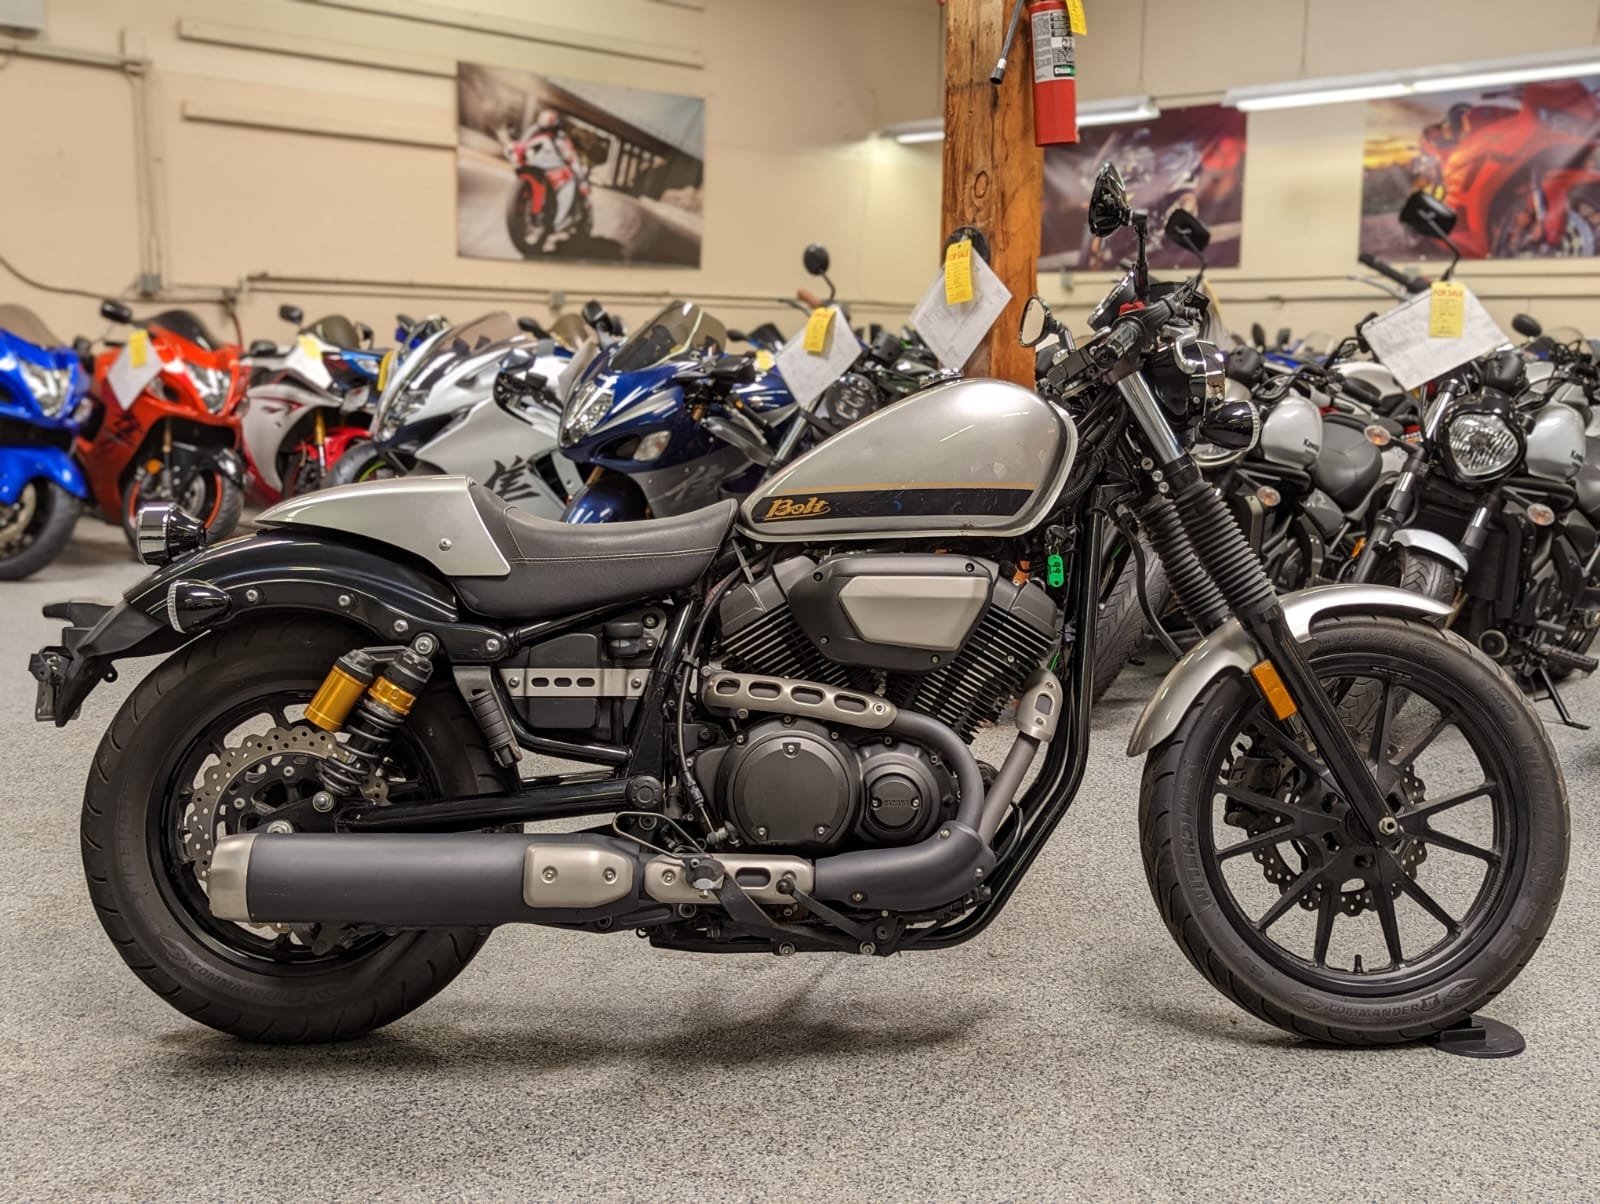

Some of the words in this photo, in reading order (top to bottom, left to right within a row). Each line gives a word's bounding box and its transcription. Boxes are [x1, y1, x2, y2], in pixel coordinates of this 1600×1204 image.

[1433, 289, 1446, 297] FOR
[1448, 289, 1464, 297] SALE
[763, 496, 832, 521] Bolt
[1328, 1003, 1420, 1018] COMMANDER
